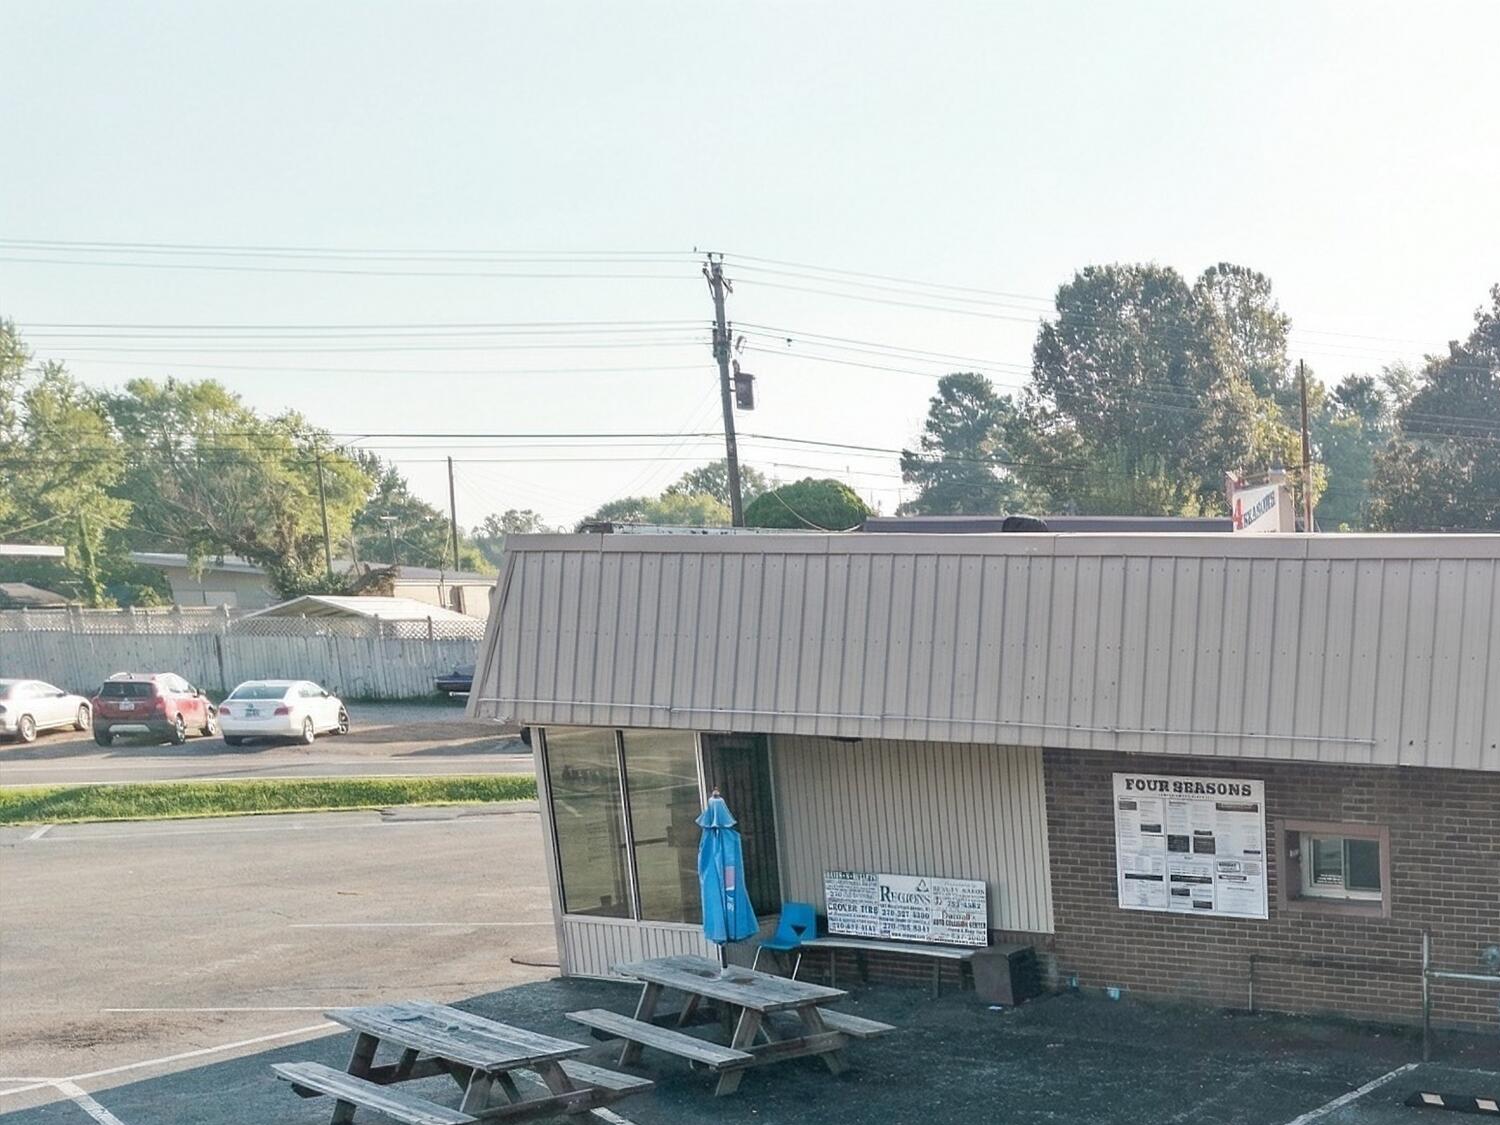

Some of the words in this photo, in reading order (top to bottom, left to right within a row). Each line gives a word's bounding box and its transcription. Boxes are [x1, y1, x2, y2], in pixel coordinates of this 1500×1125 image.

[1232, 497, 1244, 530] 4
[1125, 778, 1169, 792] FOUR
[1173, 781, 1251, 797] SEASONS
